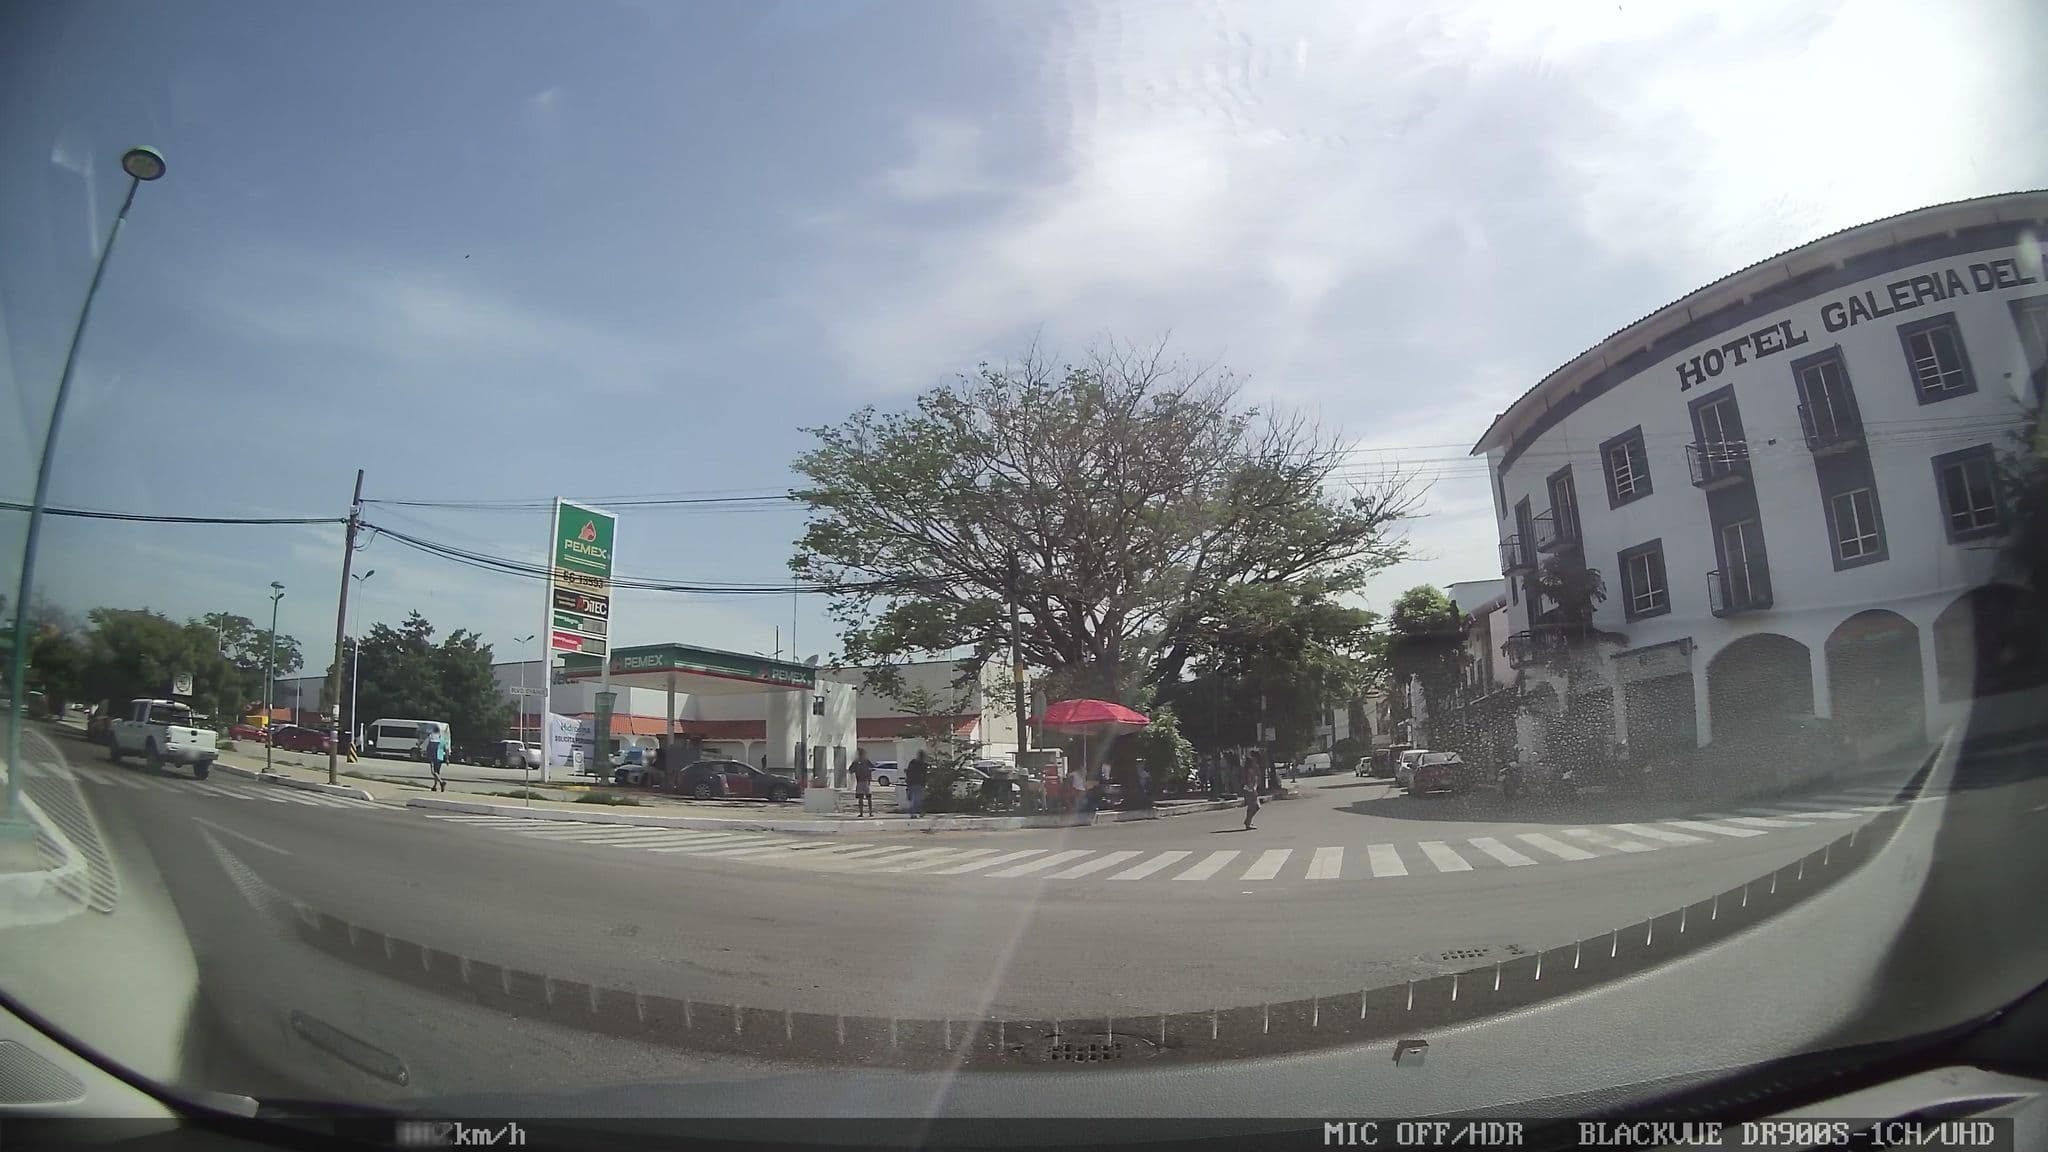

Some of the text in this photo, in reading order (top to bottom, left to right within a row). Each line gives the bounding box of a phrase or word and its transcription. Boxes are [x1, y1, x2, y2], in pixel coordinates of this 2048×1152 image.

[1676, 319, 1809, 392] HOTEL
[1820, 269, 1970, 333] GALERIA
[1968, 258, 2038, 292] DEL
[564, 539, 607, 560] PEMEX
[624, 654, 663, 668] PEMEX
[772, 668, 807, 684] PEMEX
